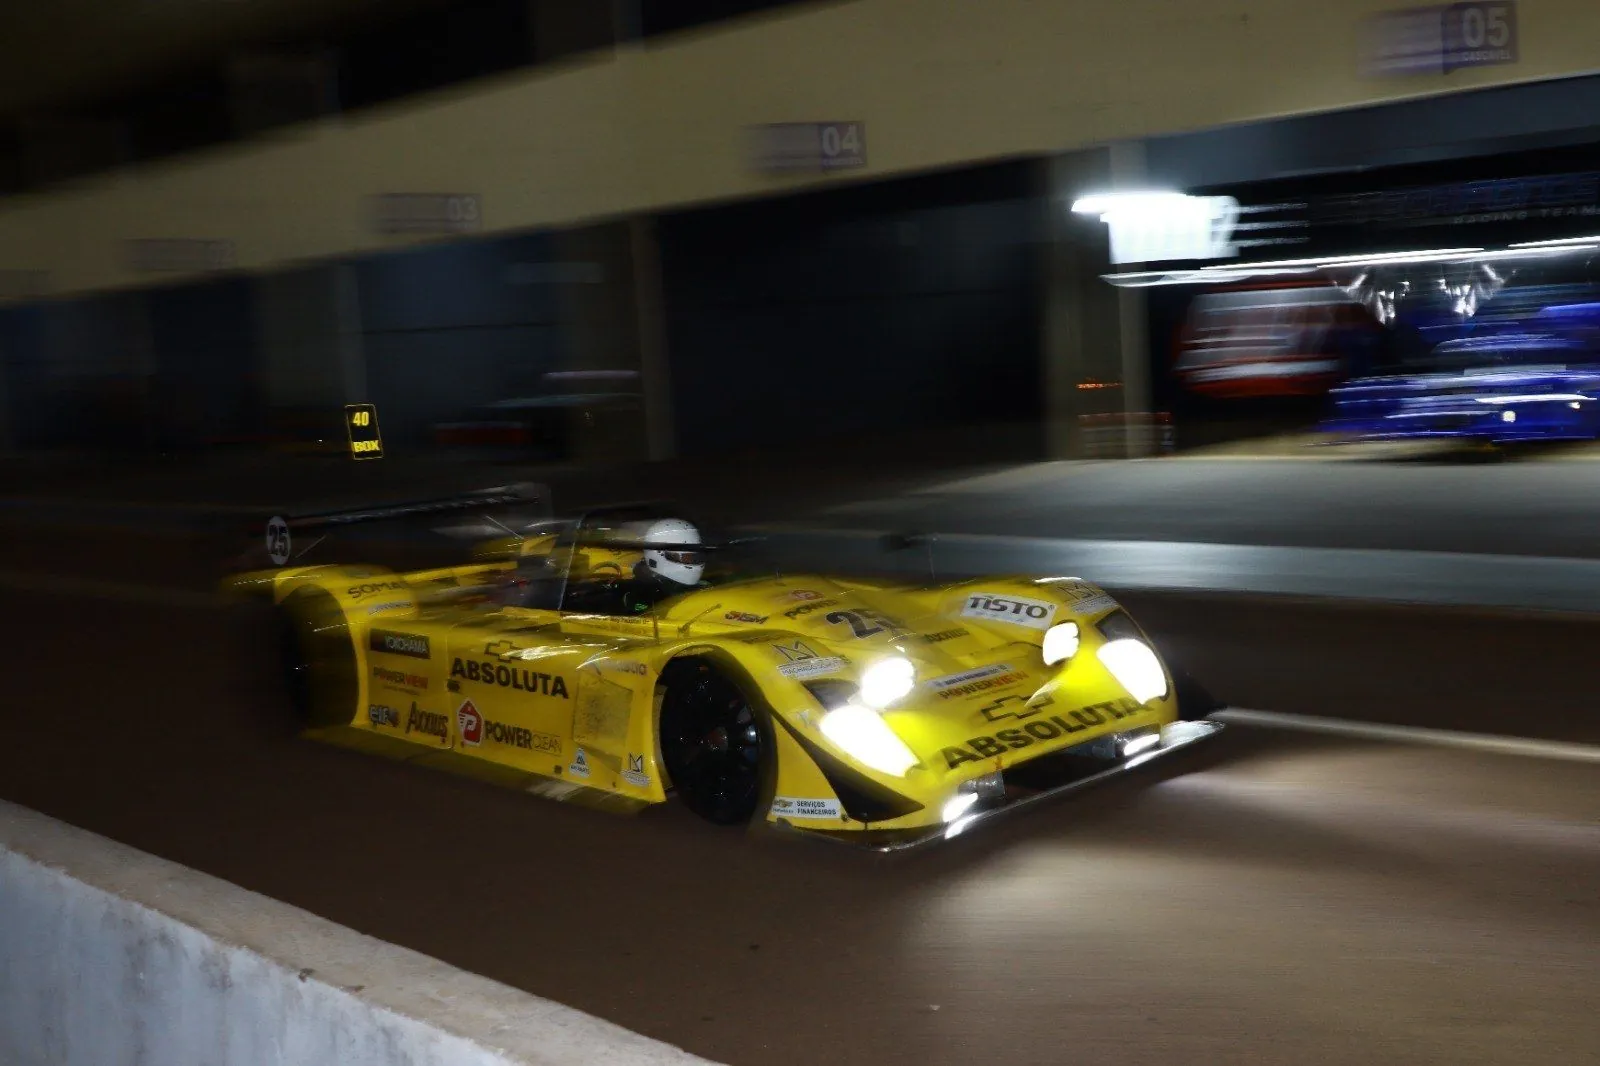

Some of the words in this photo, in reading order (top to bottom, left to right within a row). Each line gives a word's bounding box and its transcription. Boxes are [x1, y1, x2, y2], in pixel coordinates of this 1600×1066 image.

[1462, 7, 1509, 48] 05
[822, 124, 860, 156] 04
[447, 196, 478, 221] 03
[1453, 210, 1528, 224] RACING
[353, 411, 370, 427] 40
[352, 439, 380, 453] BOX
[267, 524, 289, 557] 25
[451, 658, 569, 699] ABSOLUTA
[940, 697, 1154, 770] ABSOLUTA
